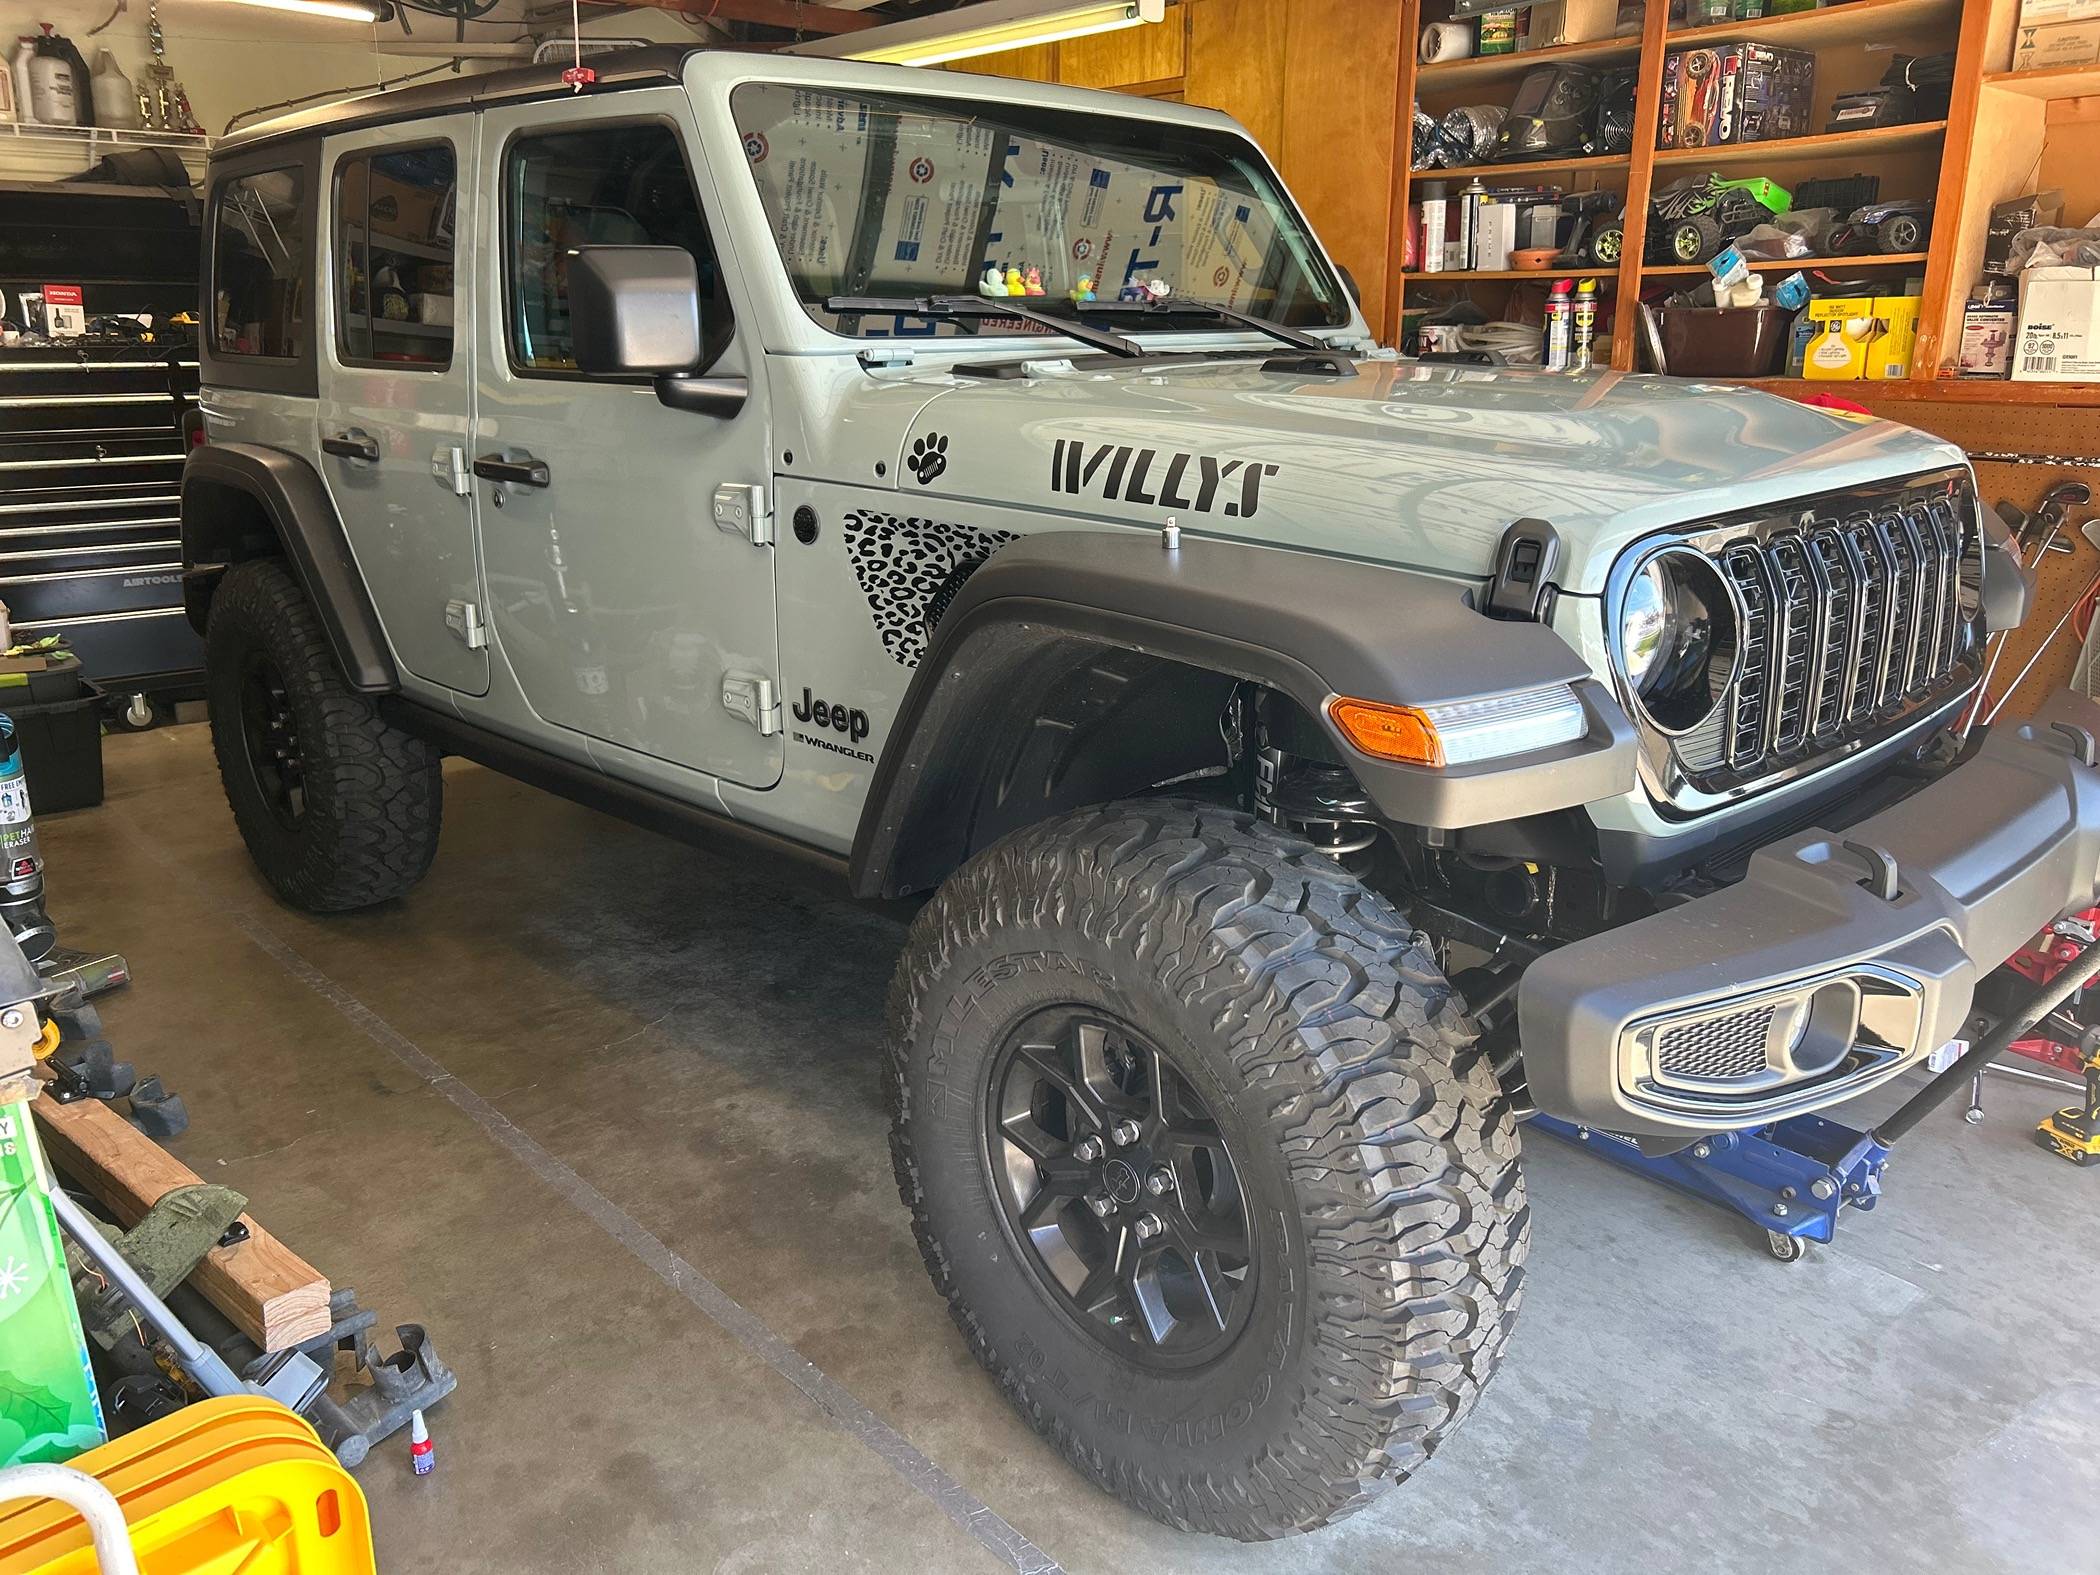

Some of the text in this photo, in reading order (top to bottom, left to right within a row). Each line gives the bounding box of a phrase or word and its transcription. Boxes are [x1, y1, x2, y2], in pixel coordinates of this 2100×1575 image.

[1052, 438, 1280, 518] WILLYS
[792, 687, 869, 743] Jeep
[804, 733, 875, 764] WRANGLER
